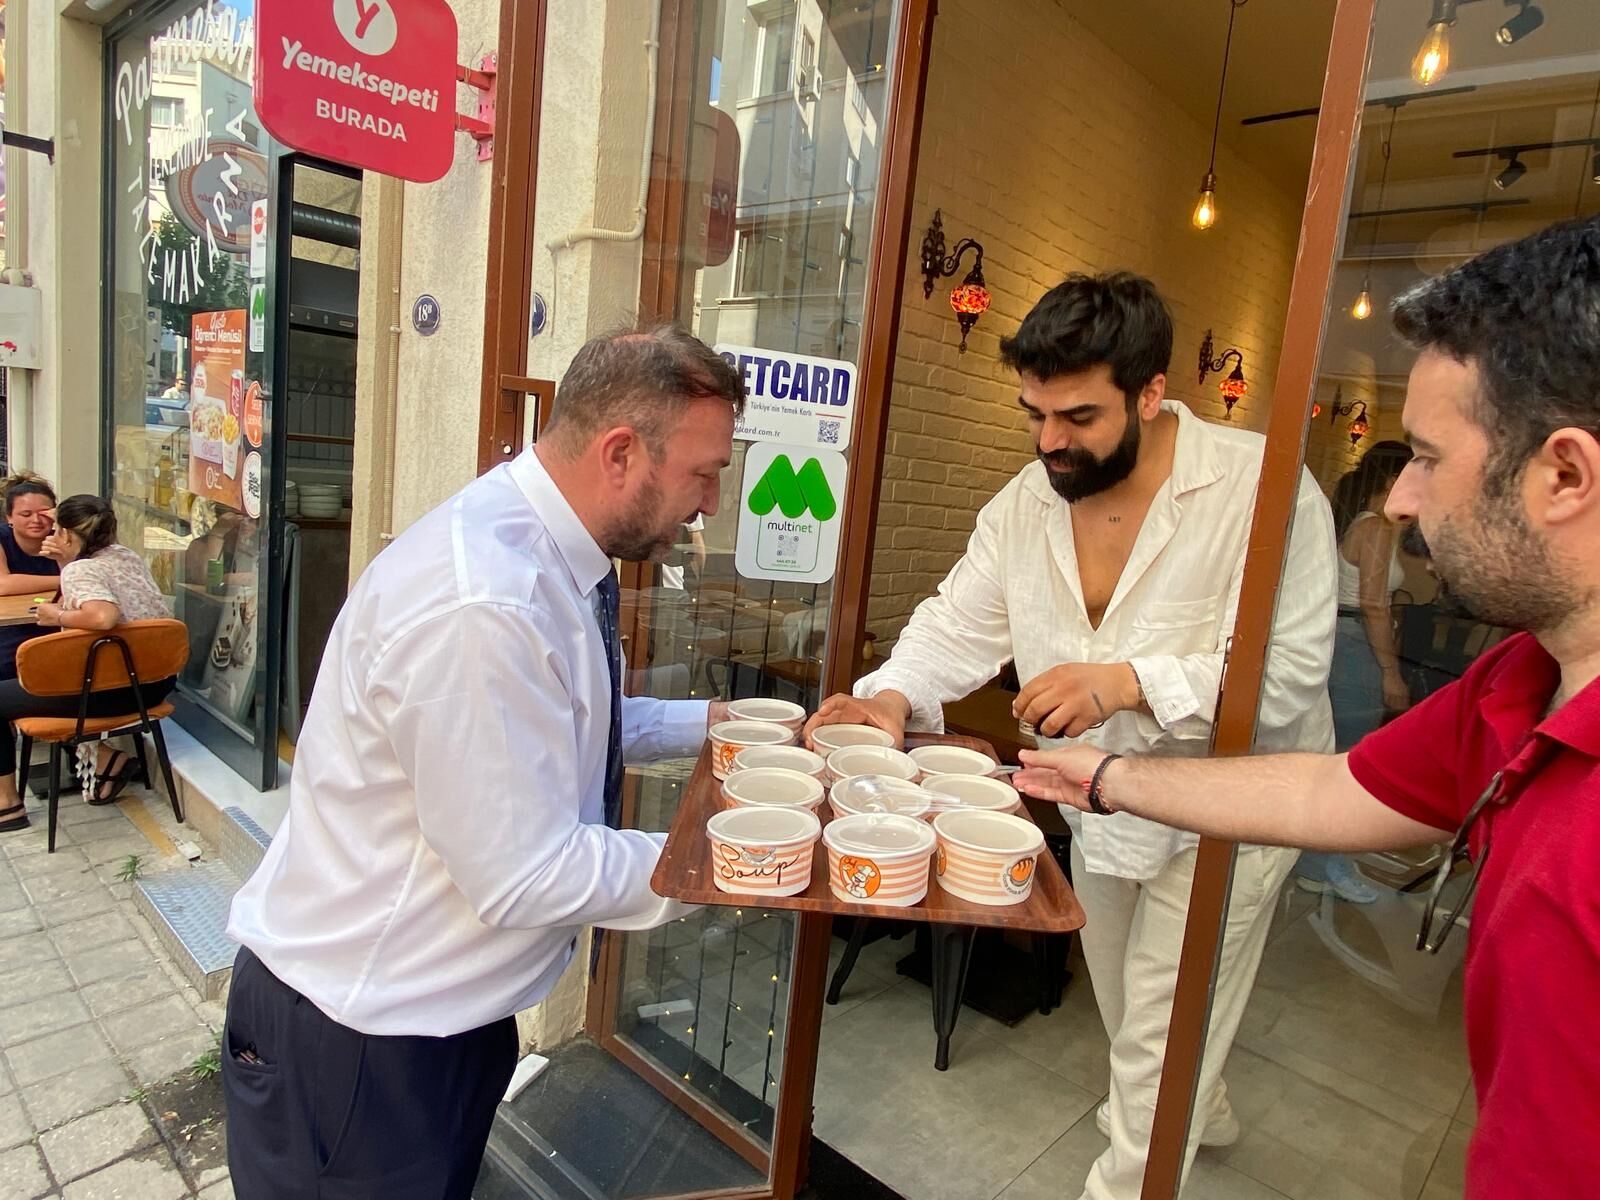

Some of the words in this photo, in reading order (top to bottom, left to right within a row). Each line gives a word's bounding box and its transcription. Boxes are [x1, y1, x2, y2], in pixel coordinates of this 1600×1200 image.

[281, 36, 439, 112] Yemeksepeti
[316, 98, 408, 142] BURADA
[767, 521, 813, 533] multinet
[719, 843, 799, 885] Soup
